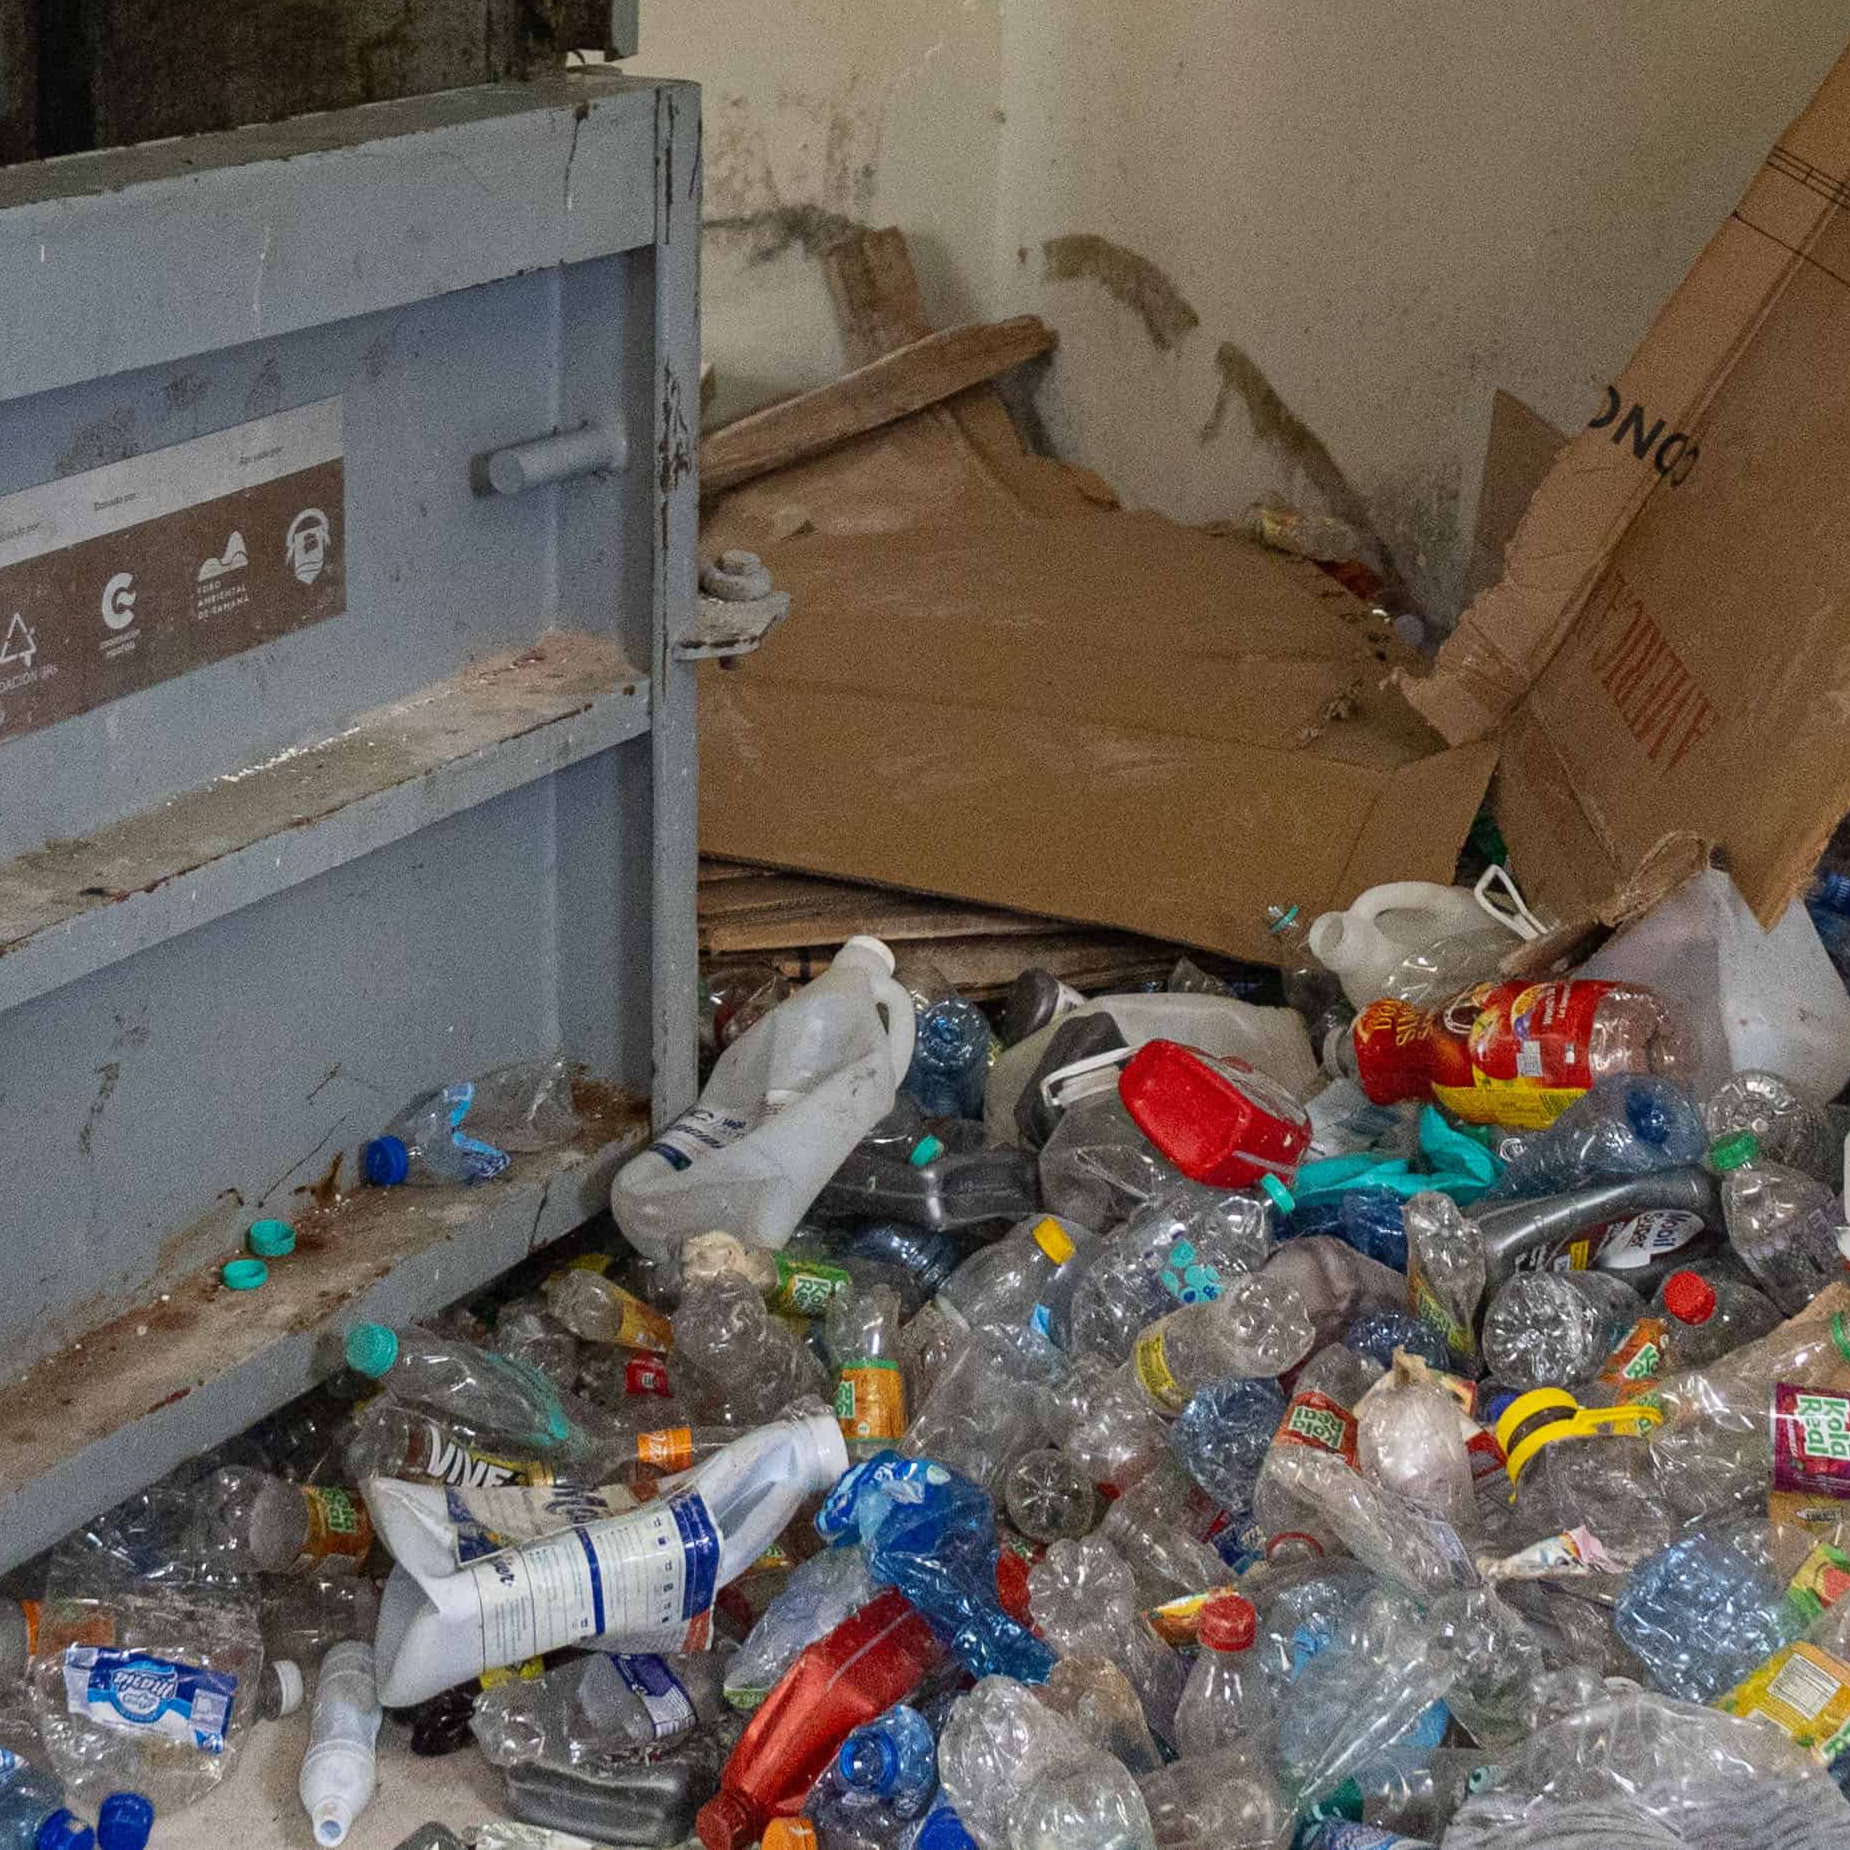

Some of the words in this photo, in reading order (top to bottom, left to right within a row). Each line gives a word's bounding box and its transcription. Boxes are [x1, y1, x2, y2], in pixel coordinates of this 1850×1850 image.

[1292, 1419, 1343, 1448] Kola
[1295, 1407, 1345, 1432] Real
[1798, 1396, 1830, 1455] Real
[1824, 1399, 1850, 1456] Kola
